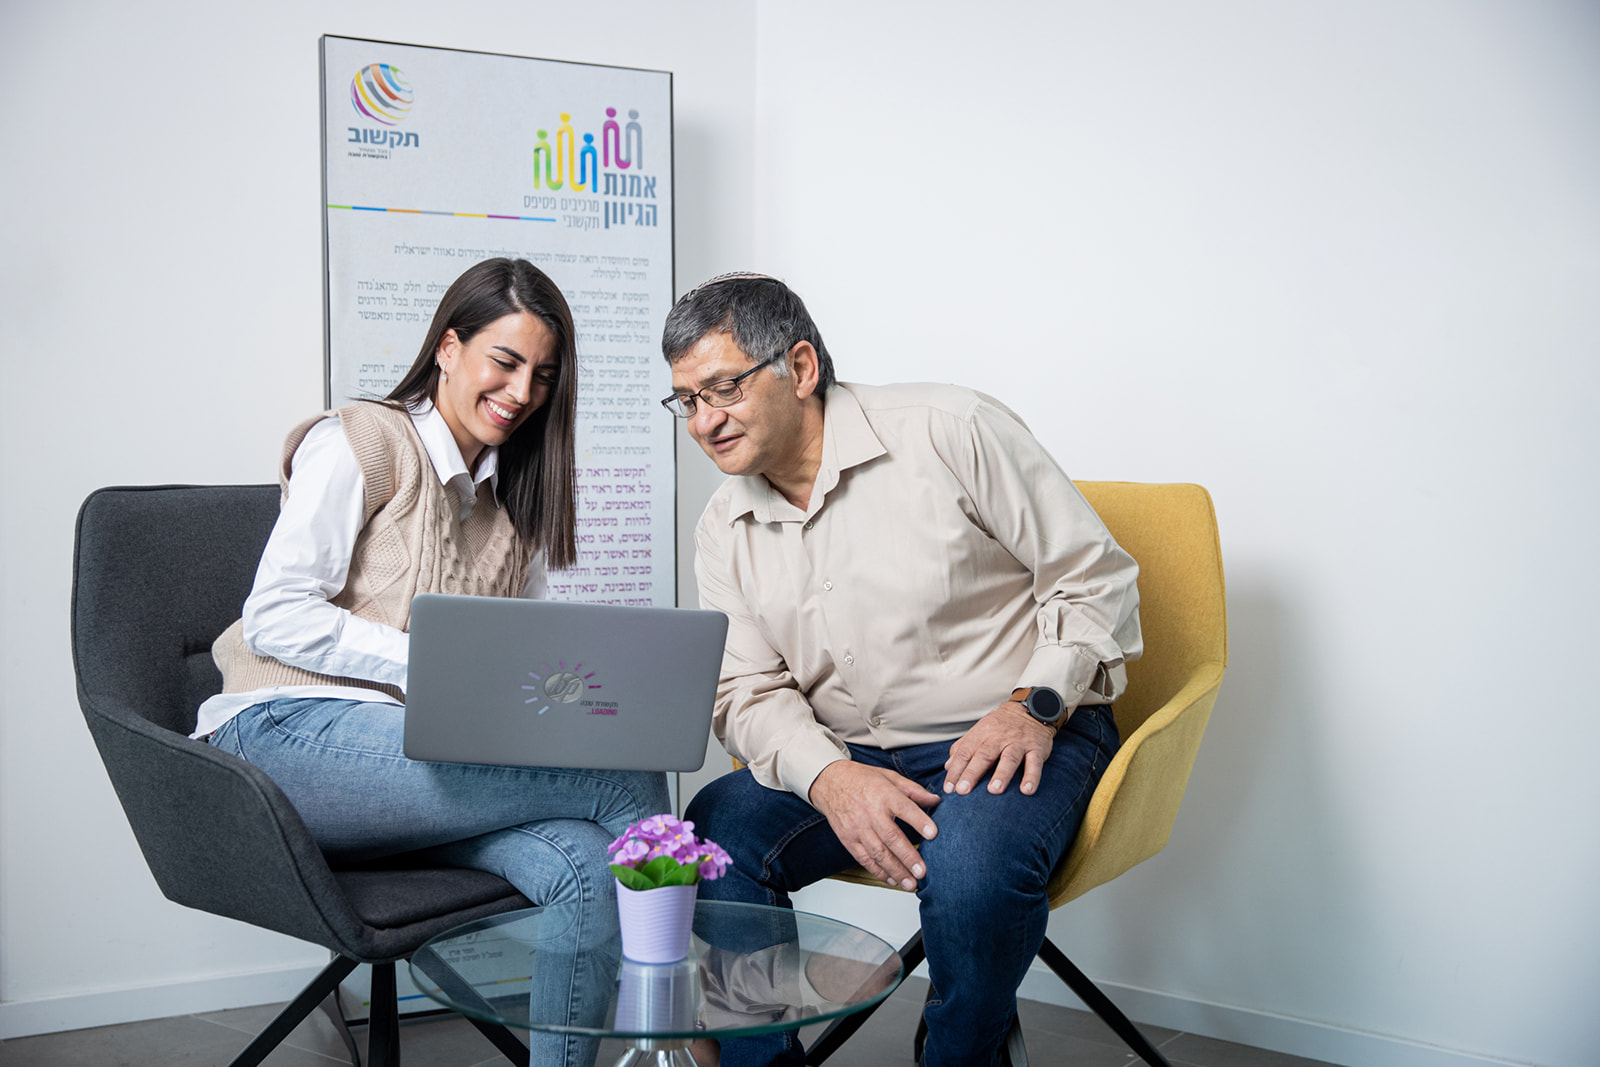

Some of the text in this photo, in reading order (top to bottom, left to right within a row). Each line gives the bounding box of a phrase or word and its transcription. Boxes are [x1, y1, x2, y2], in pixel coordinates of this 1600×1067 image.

[348, 127, 419, 148] תקשוב
[603, 173, 656, 199] אמנת
[523, 195, 600, 213] מרכיבים פסיפס
[604, 201, 657, 230] הגיוון
[563, 214, 600, 231] תקשובי
[394, 242, 431, 255] ישראלית
[433, 247, 455, 257] גאווה
[457, 248, 485, 260] בקידום
[555, 253, 577, 264] עצמה
[579, 254, 599, 264] רואה
[632, 257, 649, 267] מיום
[404, 280, 421, 294] חלק
[357, 295, 387, 305] הדרגים
[392, 294, 409, 307] בכל
[595, 305, 608, 313] היא
[358, 311, 393, 321] ומאפשר
[396, 312, 419, 323] מקדם
[593, 333, 606, 342] את
[608, 332, 632, 343] לממש
[638, 356, 650, 364] אנו
[359, 363, 385, 373] דתיים,
[359, 378, 399, 387] פנסיונרים
[597, 397, 615, 405] אשר
[601, 411, 624, 420] שירות
[586, 468, 611, 478] רואה
[614, 464, 651, 479] "תקשוב
[592, 485, 612, 494] ראוי
[615, 484, 635, 494] אדם
[639, 480, 651, 493] כל
[584, 497, 598, 512] על
[602, 500, 651, 512] המאמצים,
[625, 513, 651, 526] להיות
[599, 534, 614, 543] אנו
[619, 533, 652, 544] אנשים,
[603, 550, 629, 559] ואשר
[632, 549, 652, 559] אדם
[594, 566, 618, 576] טובה
[623, 565, 652, 575] סביבה
[552, 584, 572, 594] דבר
[574, 583, 598, 596] שאין
[601, 582, 635, 594] ומבינה,
[638, 582, 652, 592] יום
